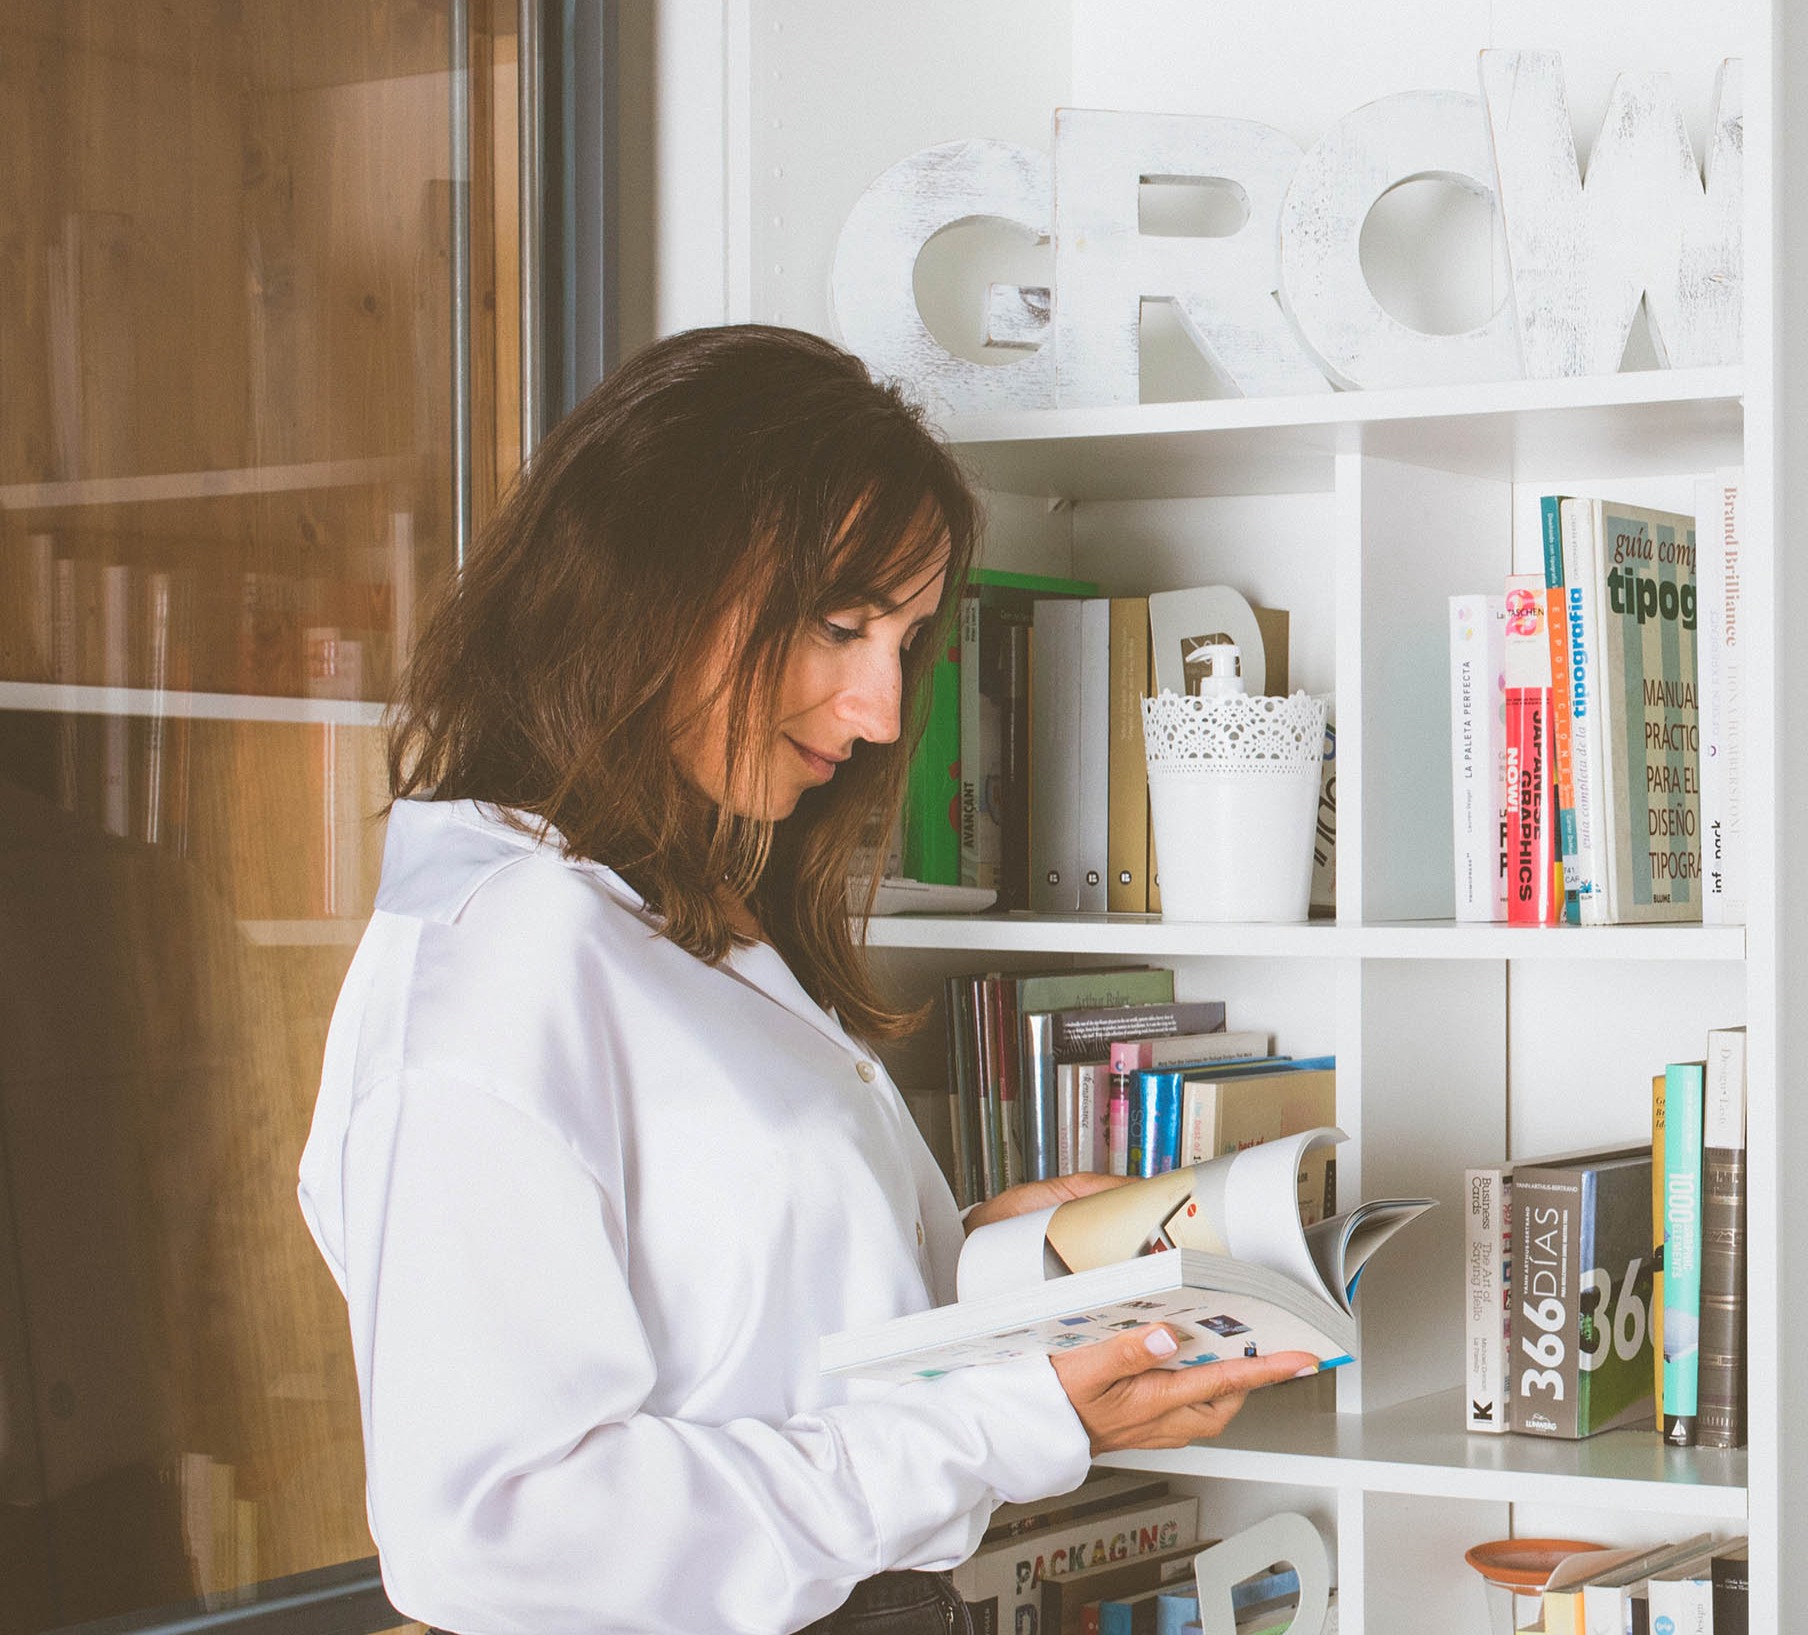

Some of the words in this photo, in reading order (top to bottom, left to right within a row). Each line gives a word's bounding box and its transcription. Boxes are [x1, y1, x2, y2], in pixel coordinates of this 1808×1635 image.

[831, 49, 1743, 412] GROW
[1724, 487, 1738, 546] Brand
[1614, 527, 1653, 564] guía
[1507, 608, 1545, 617] TASCHEN
[1607, 566, 1697, 631] tipog
[1725, 551, 1740, 648] Brilliance
[1463, 661, 1471, 715] PERFECTA
[1643, 679, 1698, 710] MANUAL
[1464, 720, 1472, 761] PALETA
[1465, 765, 1473, 778] LA
[1507, 747, 1518, 813] NOW!
[1532, 710, 1543, 840] JAPANESE
[1647, 765, 1681, 793] PARA
[1685, 767, 1698, 794] EL
[963, 781, 976, 849] AVANÇANT
[1519, 770, 1532, 902] GRAPHICS
[1648, 803, 1695, 837] DISEÑO
[1238, 1138, 1255, 1151] best
[1472, 1176, 1481, 1215] Cards
[1482, 1177, 1491, 1230] Business
[1668, 1172, 1695, 1223] 1000
[1471, 1242, 1482, 1286] Saying
[1482, 1242, 1492, 1266] The
[1483, 1268, 1492, 1288] Art
[1483, 1290, 1491, 1302] of
[1473, 1290, 1483, 1321] Hello
[1579, 1258, 1655, 1372] 36
[1015, 1519, 1178, 1596] PACKAGING
